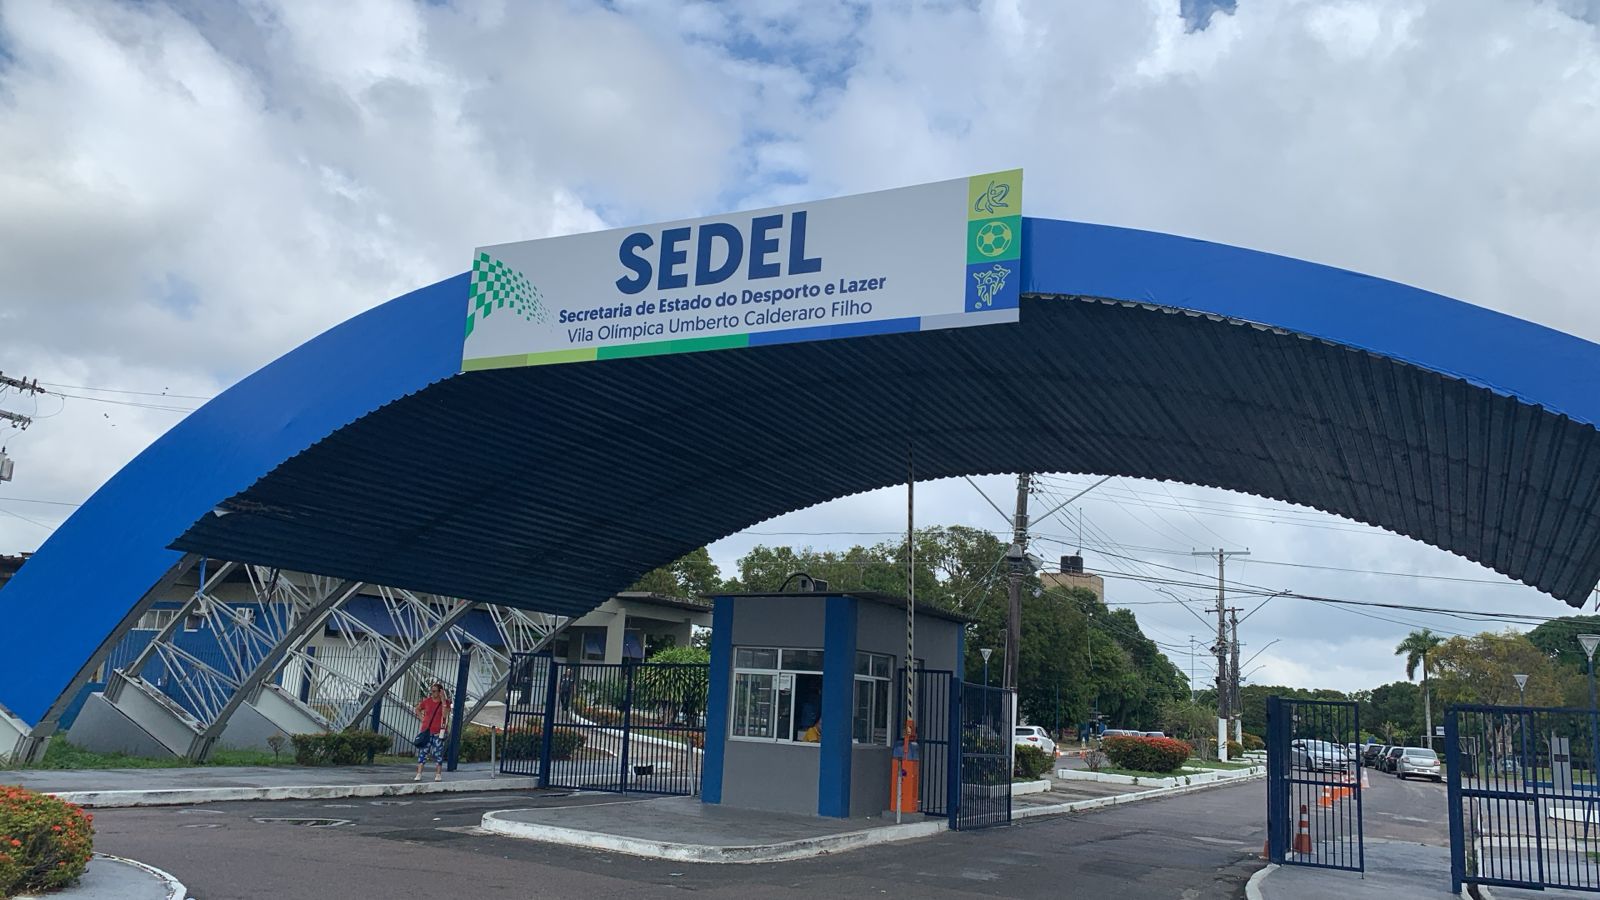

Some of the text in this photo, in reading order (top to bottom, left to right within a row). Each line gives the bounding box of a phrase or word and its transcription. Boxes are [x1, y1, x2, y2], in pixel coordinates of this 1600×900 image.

[615, 210, 822, 295] SEDEL
[559, 276, 887, 323] Secretaria de Estado do Desporto e Lazer
[567, 299, 873, 343] Vila Olímpica Umberto Calderaro Filho
